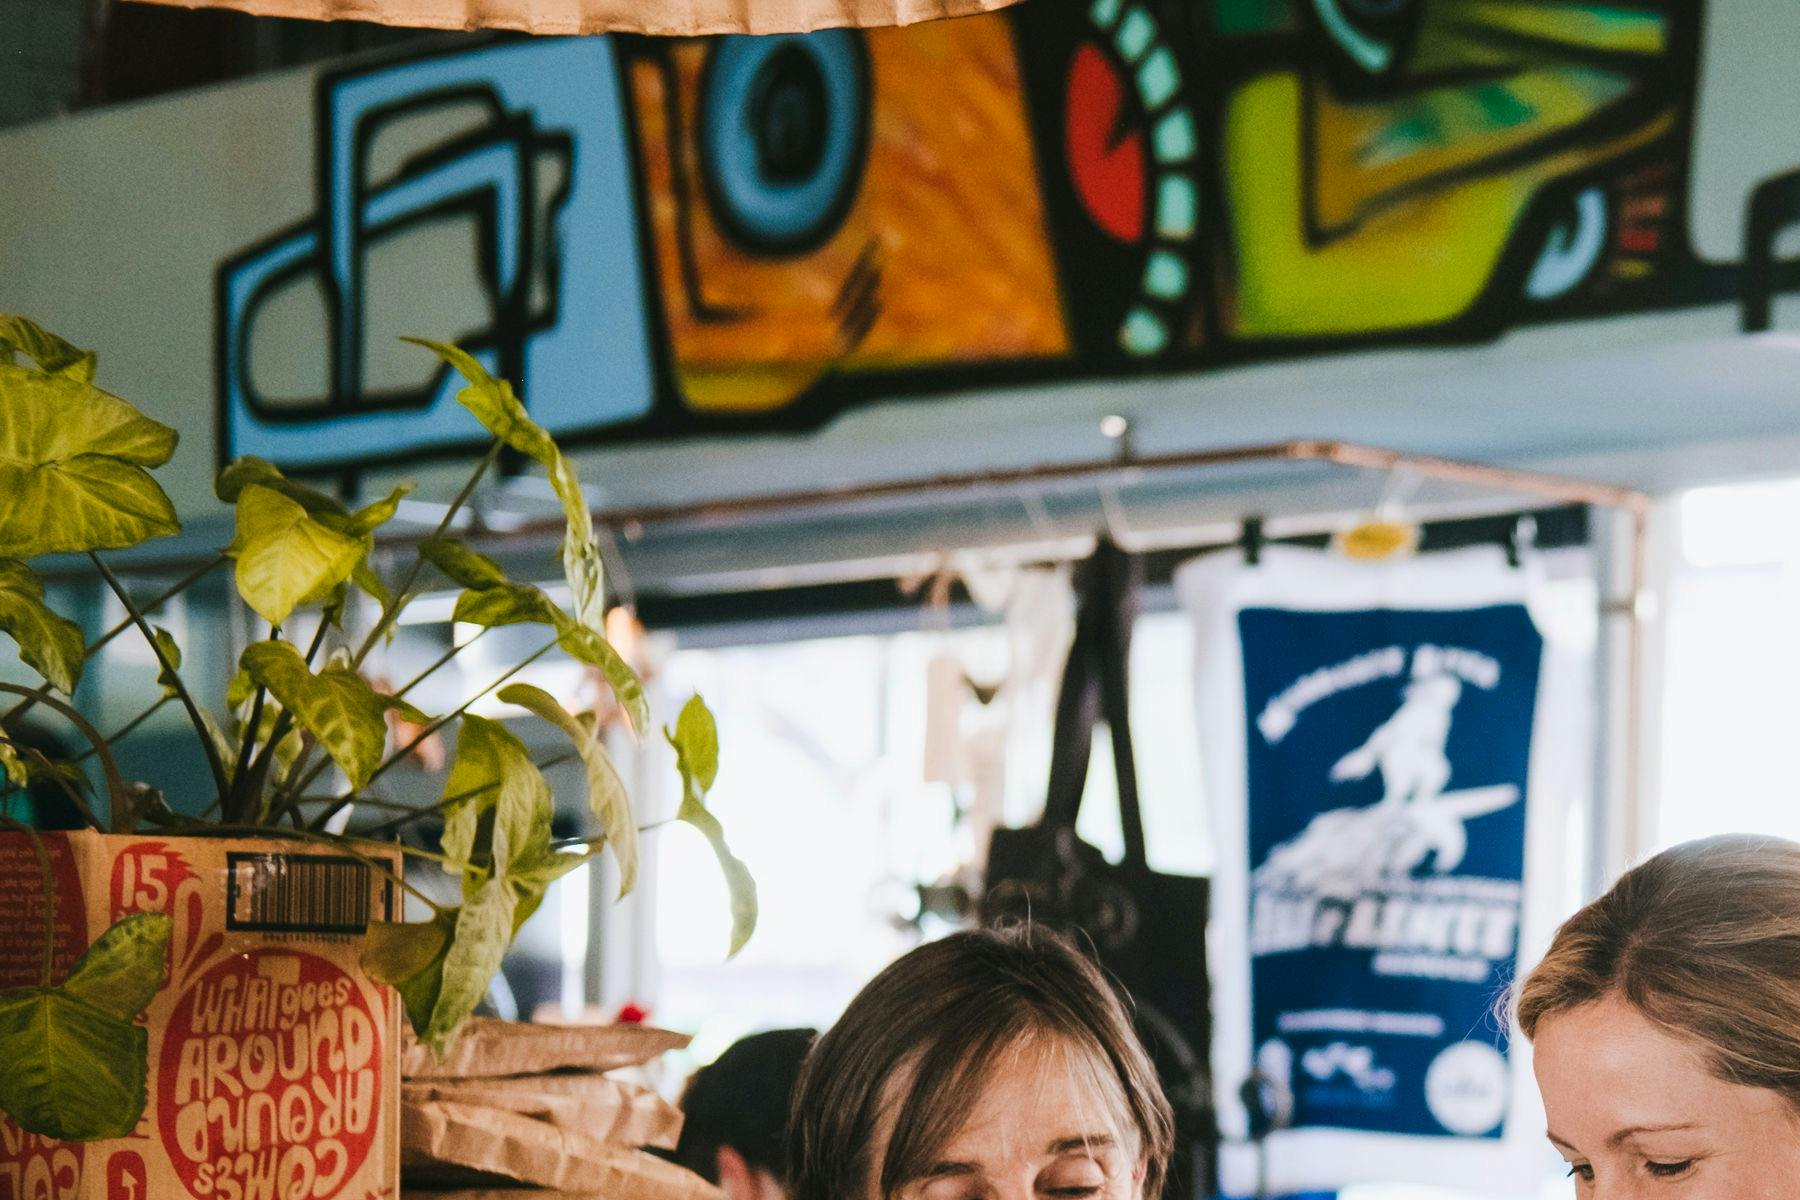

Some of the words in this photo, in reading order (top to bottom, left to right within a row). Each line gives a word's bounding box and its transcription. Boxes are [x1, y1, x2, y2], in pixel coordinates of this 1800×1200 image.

[122, 852, 168, 912] 15
[279, 976, 351, 1031] goes
[175, 1005, 374, 1105] AROUND
